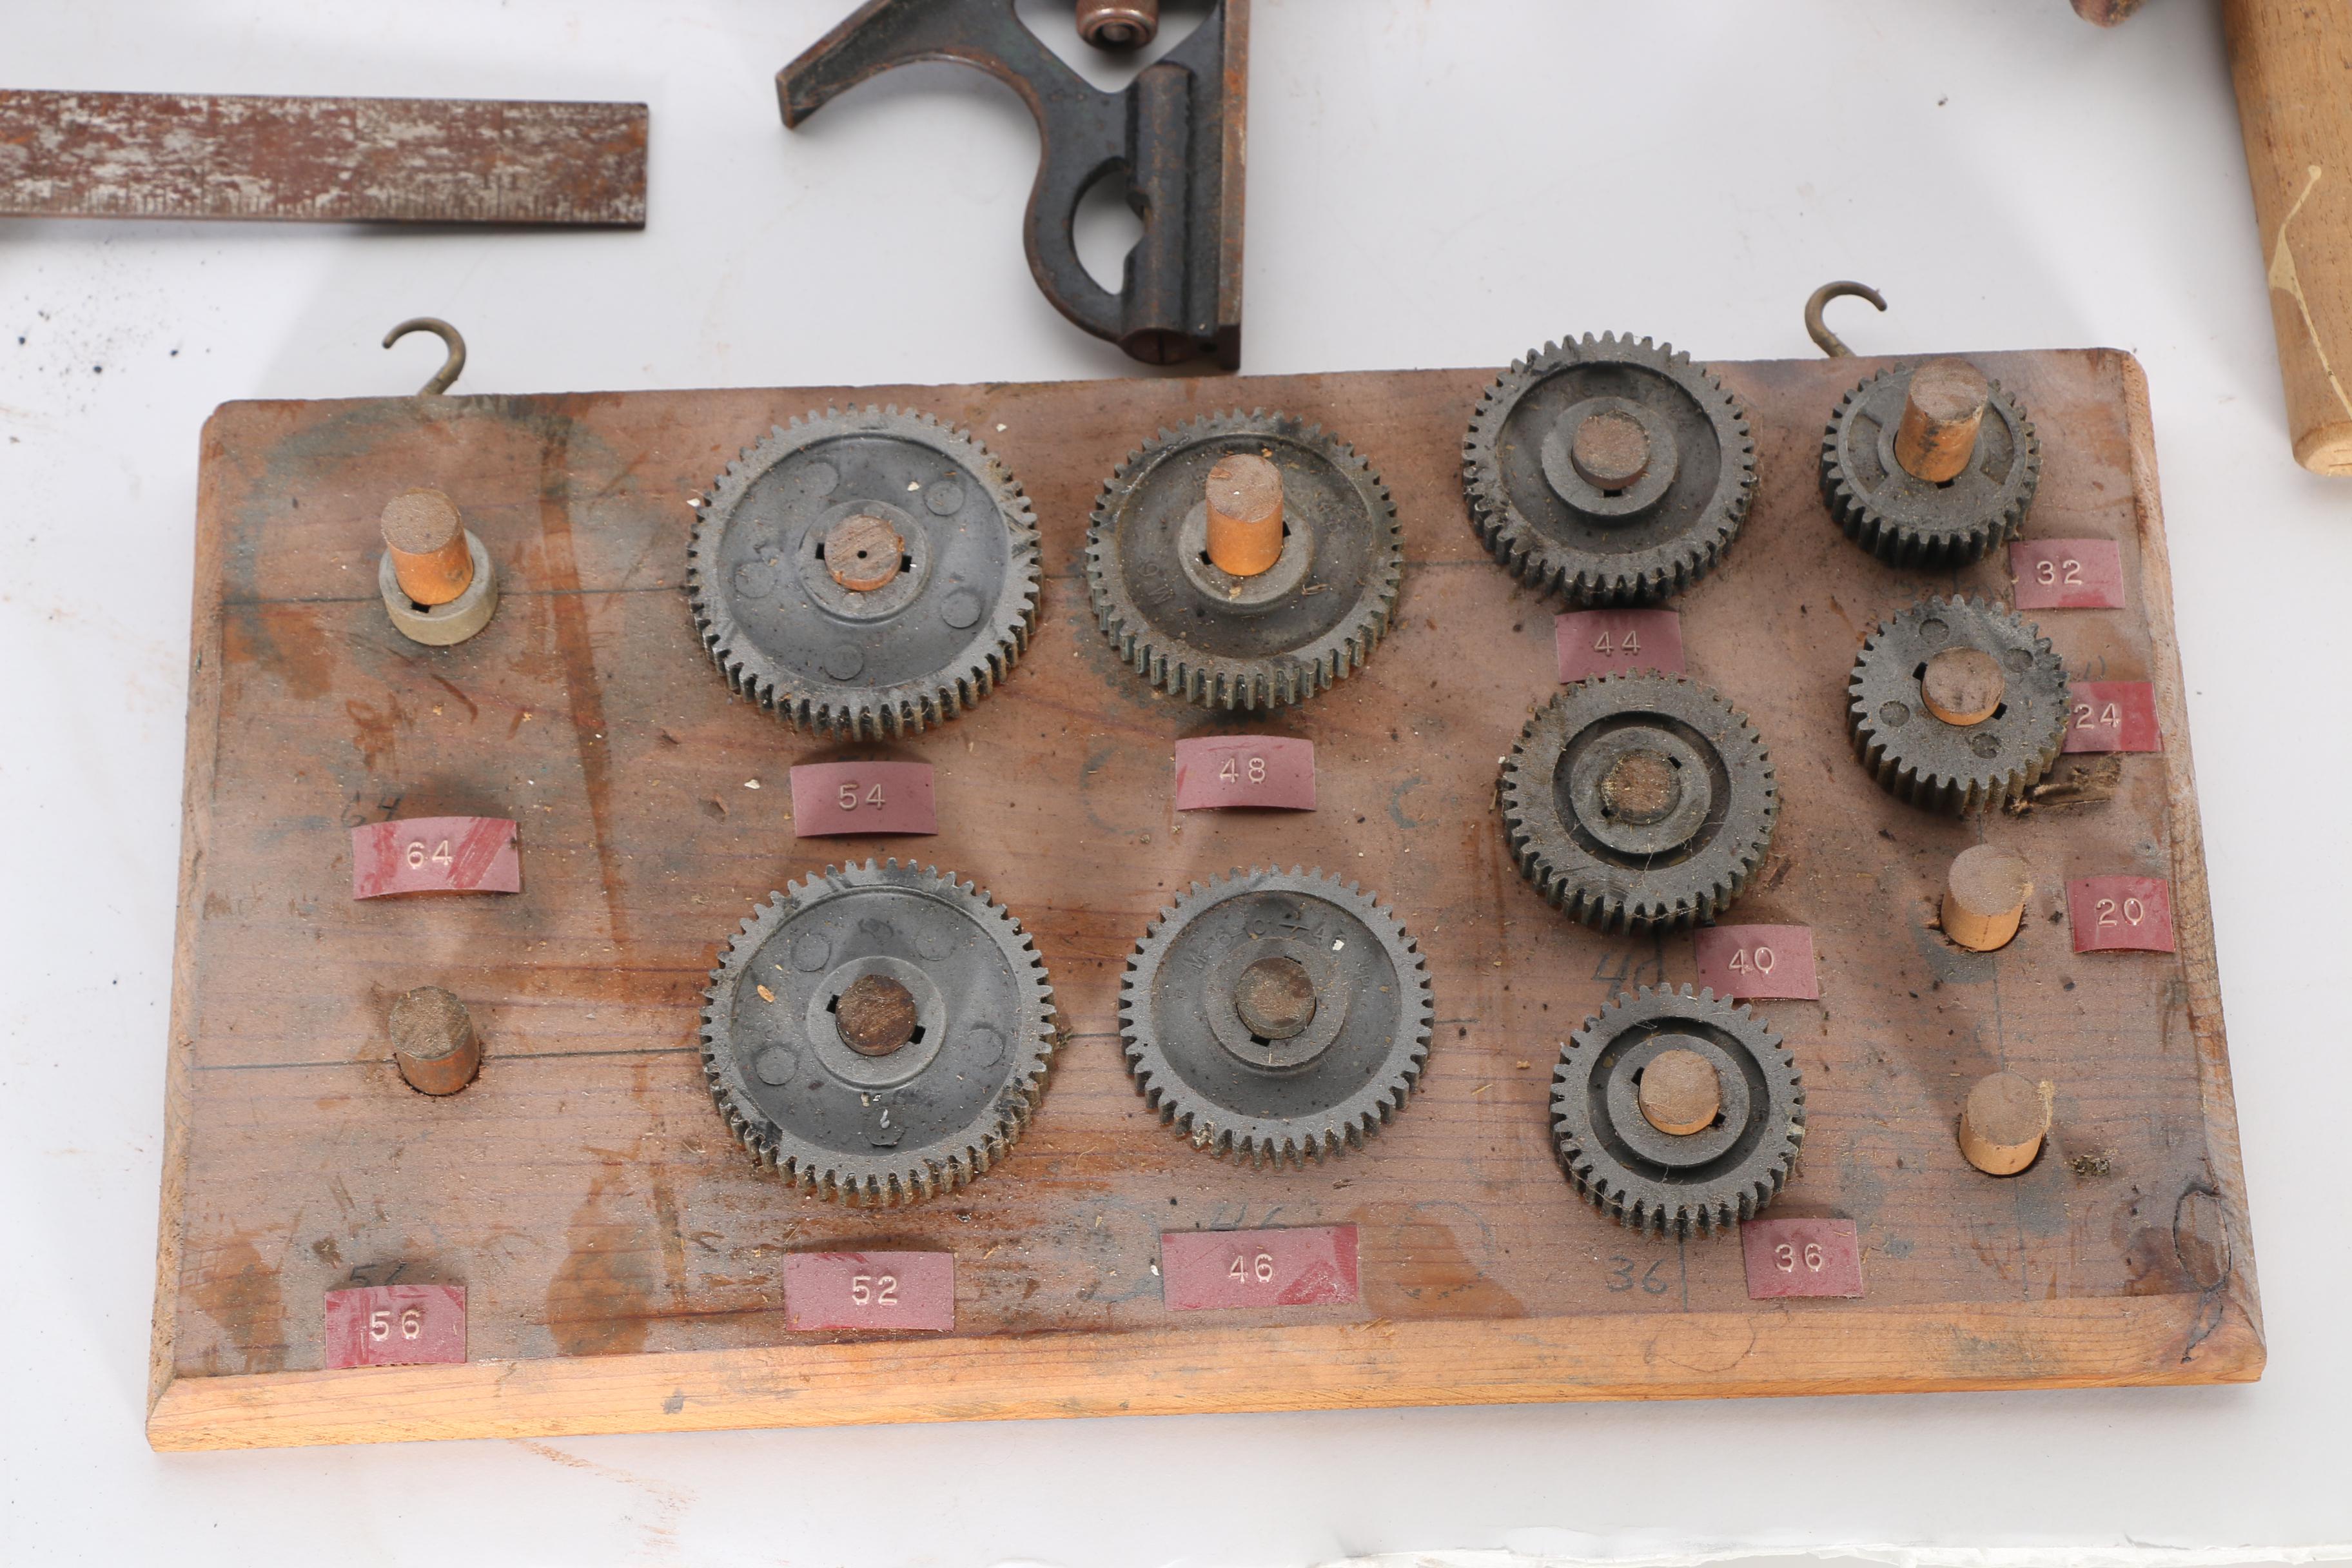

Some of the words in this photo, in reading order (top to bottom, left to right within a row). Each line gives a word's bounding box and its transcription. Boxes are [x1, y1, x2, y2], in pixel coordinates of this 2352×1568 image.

[2036, 560, 2083, 585] 32
[1594, 631, 1642, 656] 44
[2073, 703, 2121, 729] 24
[1219, 758, 1266, 783] 48
[839, 783, 886, 810] 54
[407, 840, 453, 869] 64
[2096, 898, 2144, 926] 20
[1728, 946, 1774, 974] 40
[1228, 1253, 1273, 1283] 46
[1774, 1243, 1823, 1272] 36
[1606, 1254, 1668, 1295] 36
[852, 1275, 898, 1305] 52
[369, 1309, 420, 1342] 56
